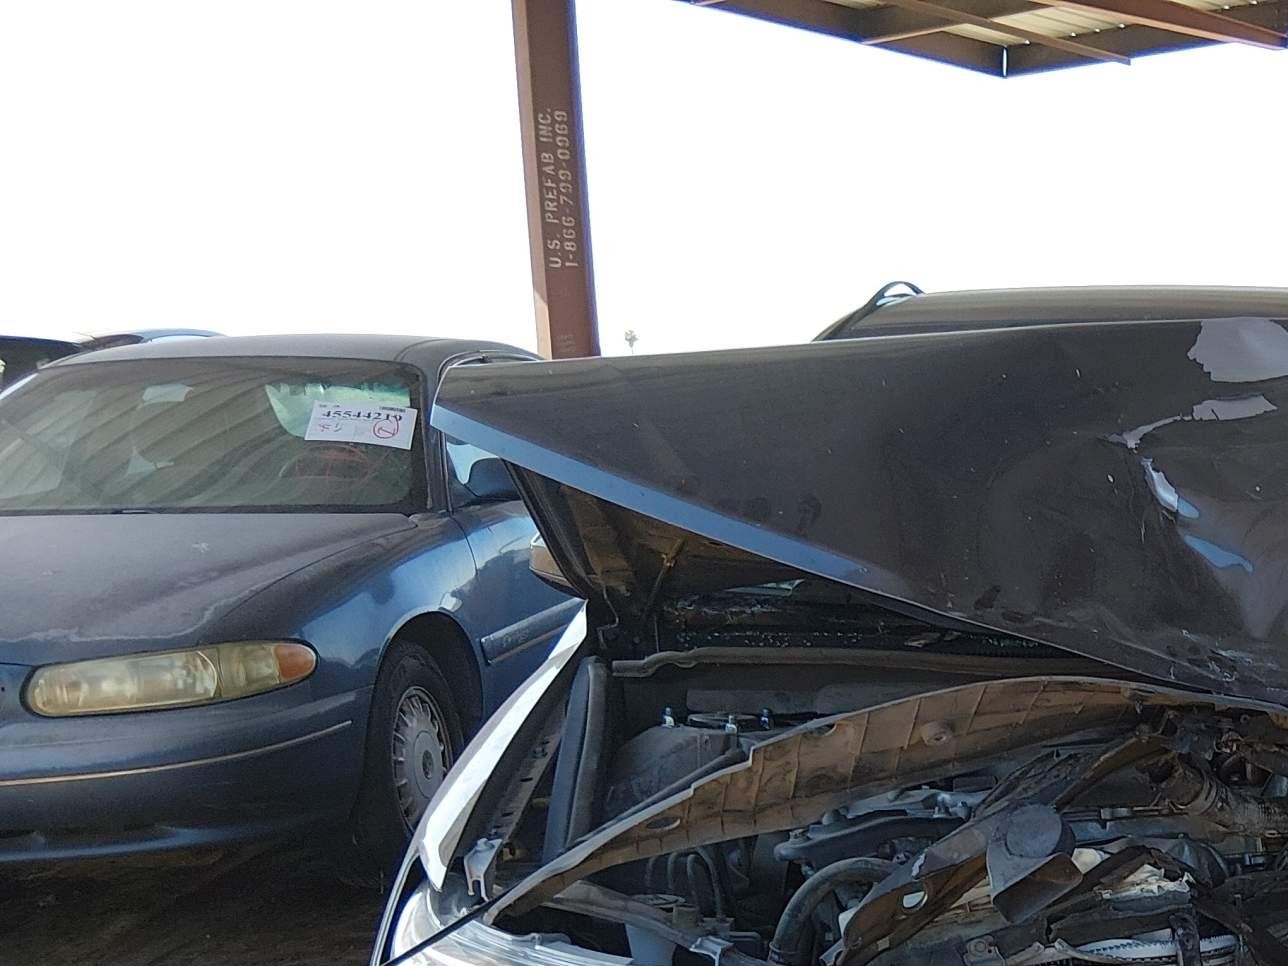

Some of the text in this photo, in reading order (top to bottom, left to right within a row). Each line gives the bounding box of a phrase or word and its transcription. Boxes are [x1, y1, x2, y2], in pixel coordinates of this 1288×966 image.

[538, 108, 562, 268] U.S. PREFAB INC.
